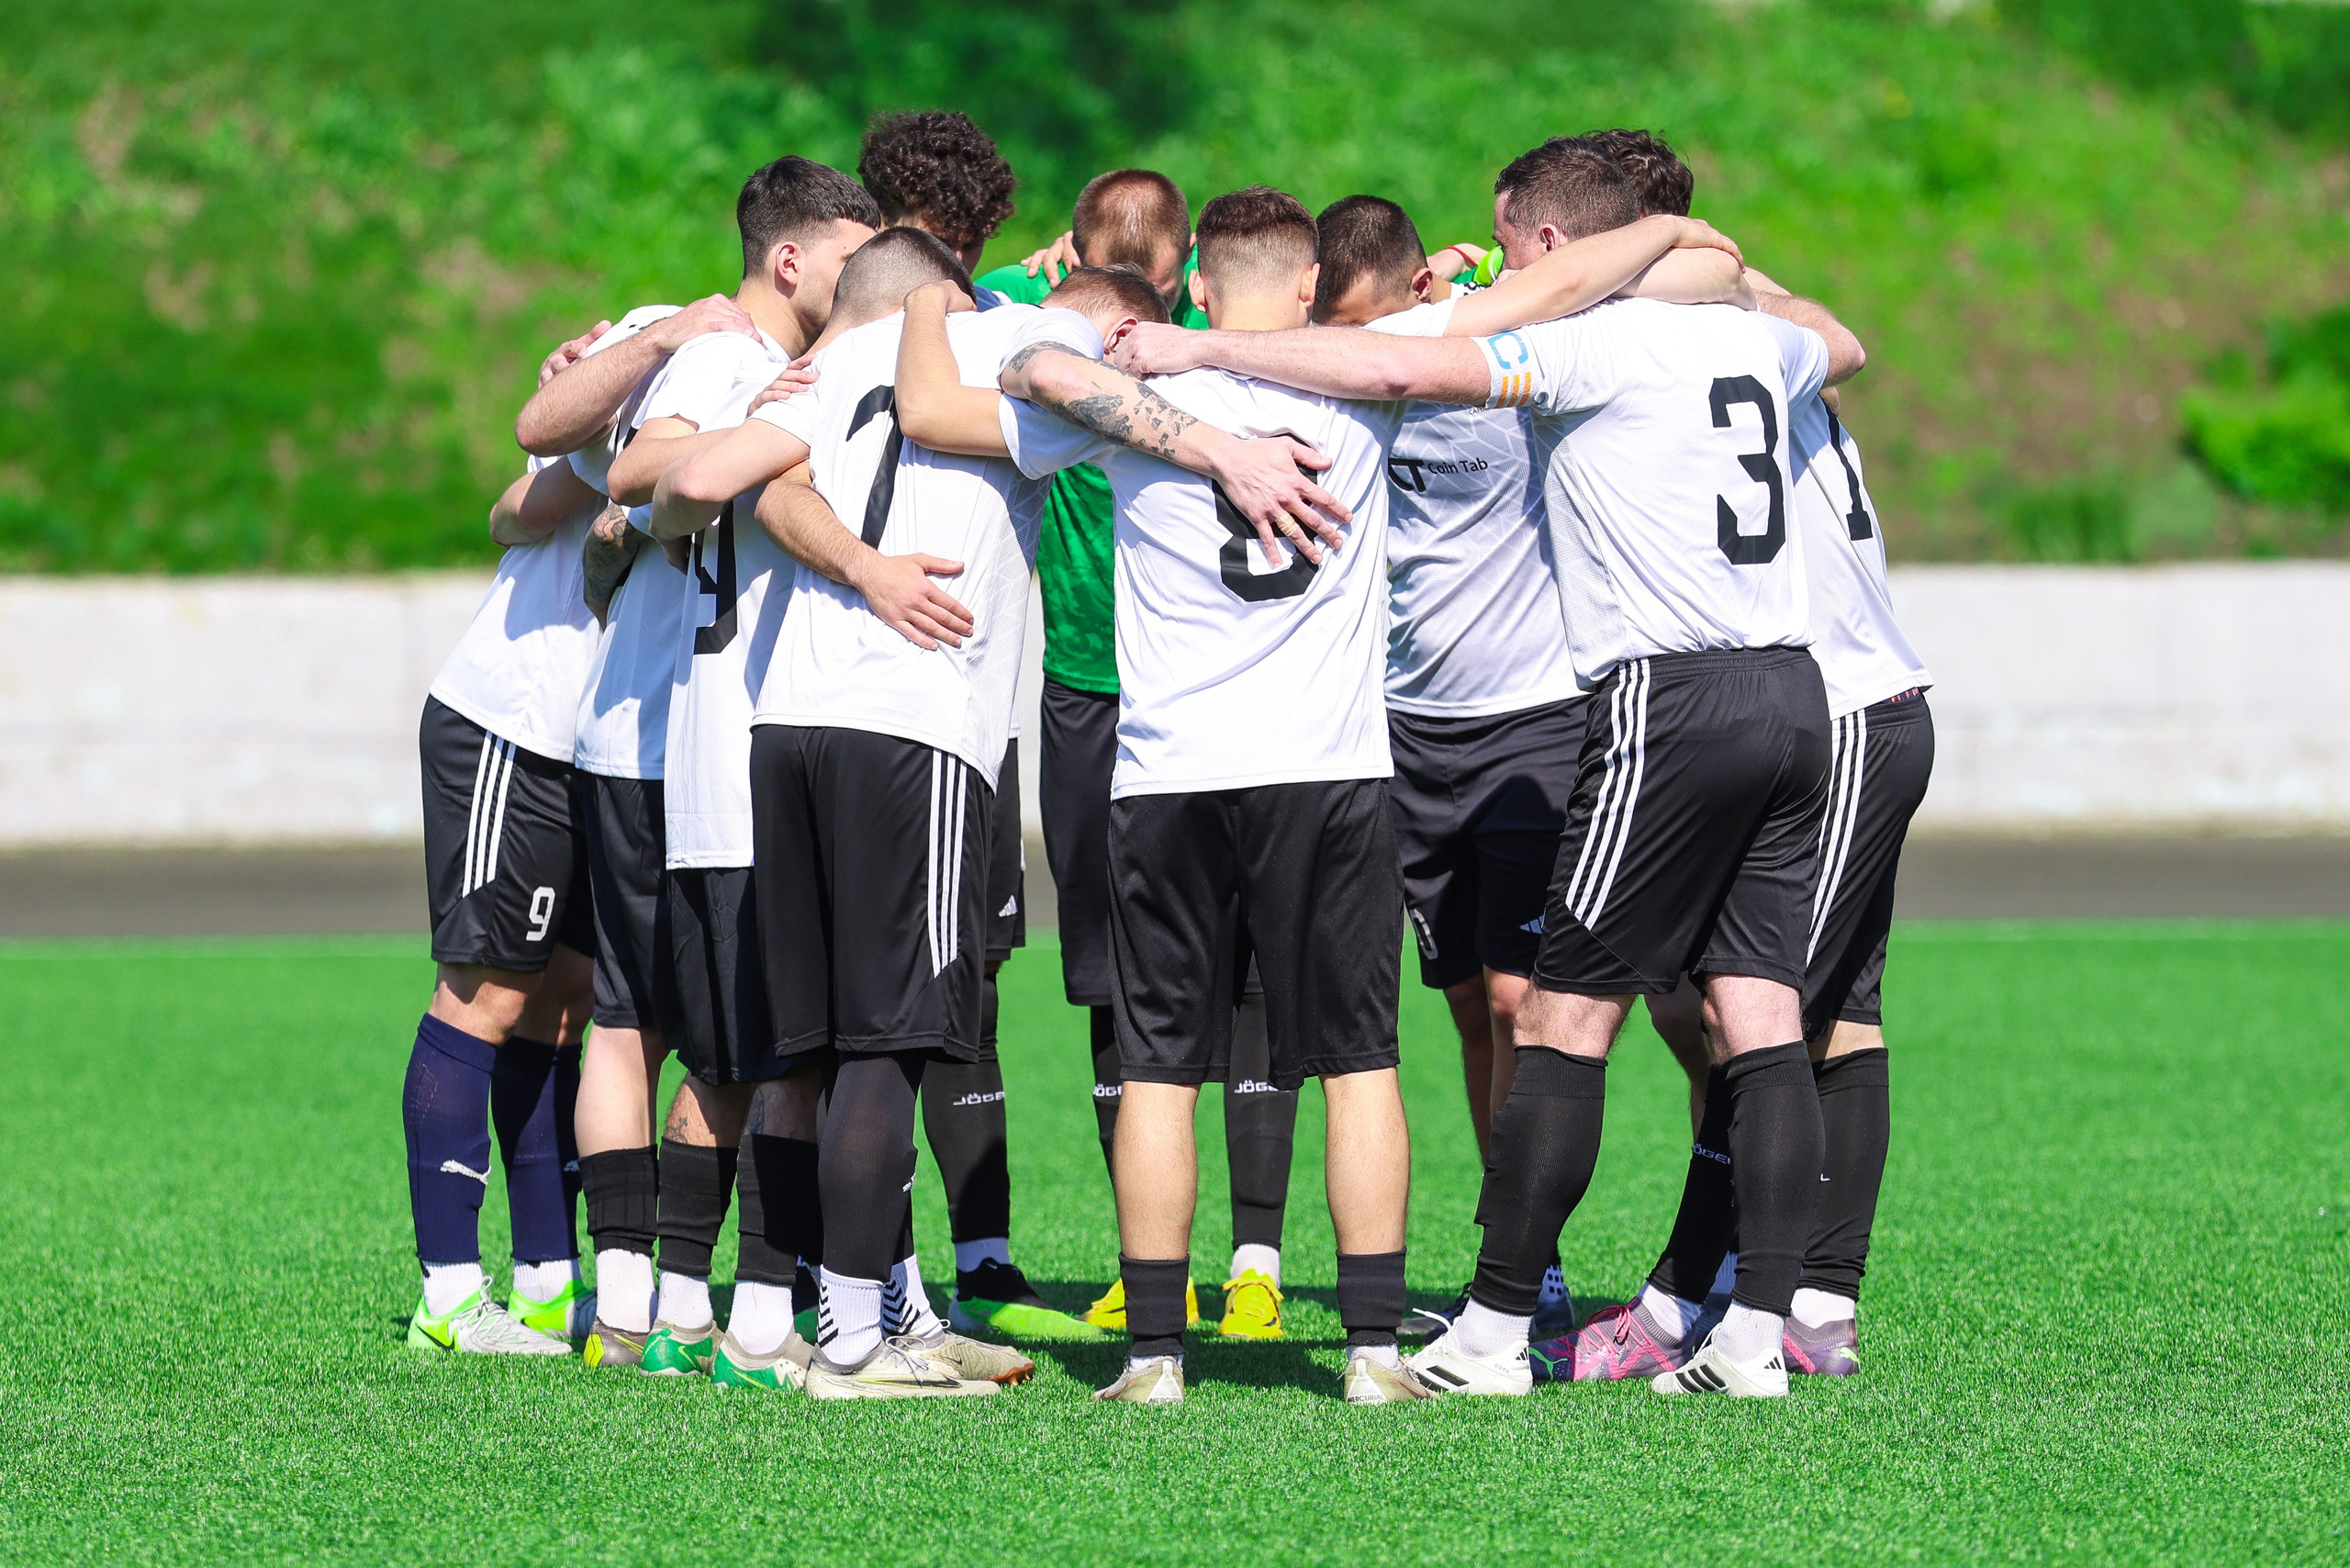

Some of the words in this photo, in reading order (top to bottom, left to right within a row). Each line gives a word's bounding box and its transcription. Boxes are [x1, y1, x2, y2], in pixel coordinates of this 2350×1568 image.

[1427, 462, 1459, 475] Coin
[1460, 458, 1488, 473] Tab
[1708, 375, 1785, 565] 3
[693, 500, 738, 655] 9
[526, 886, 555, 941] 9
[953, 1091, 1005, 1105] JÖGE
